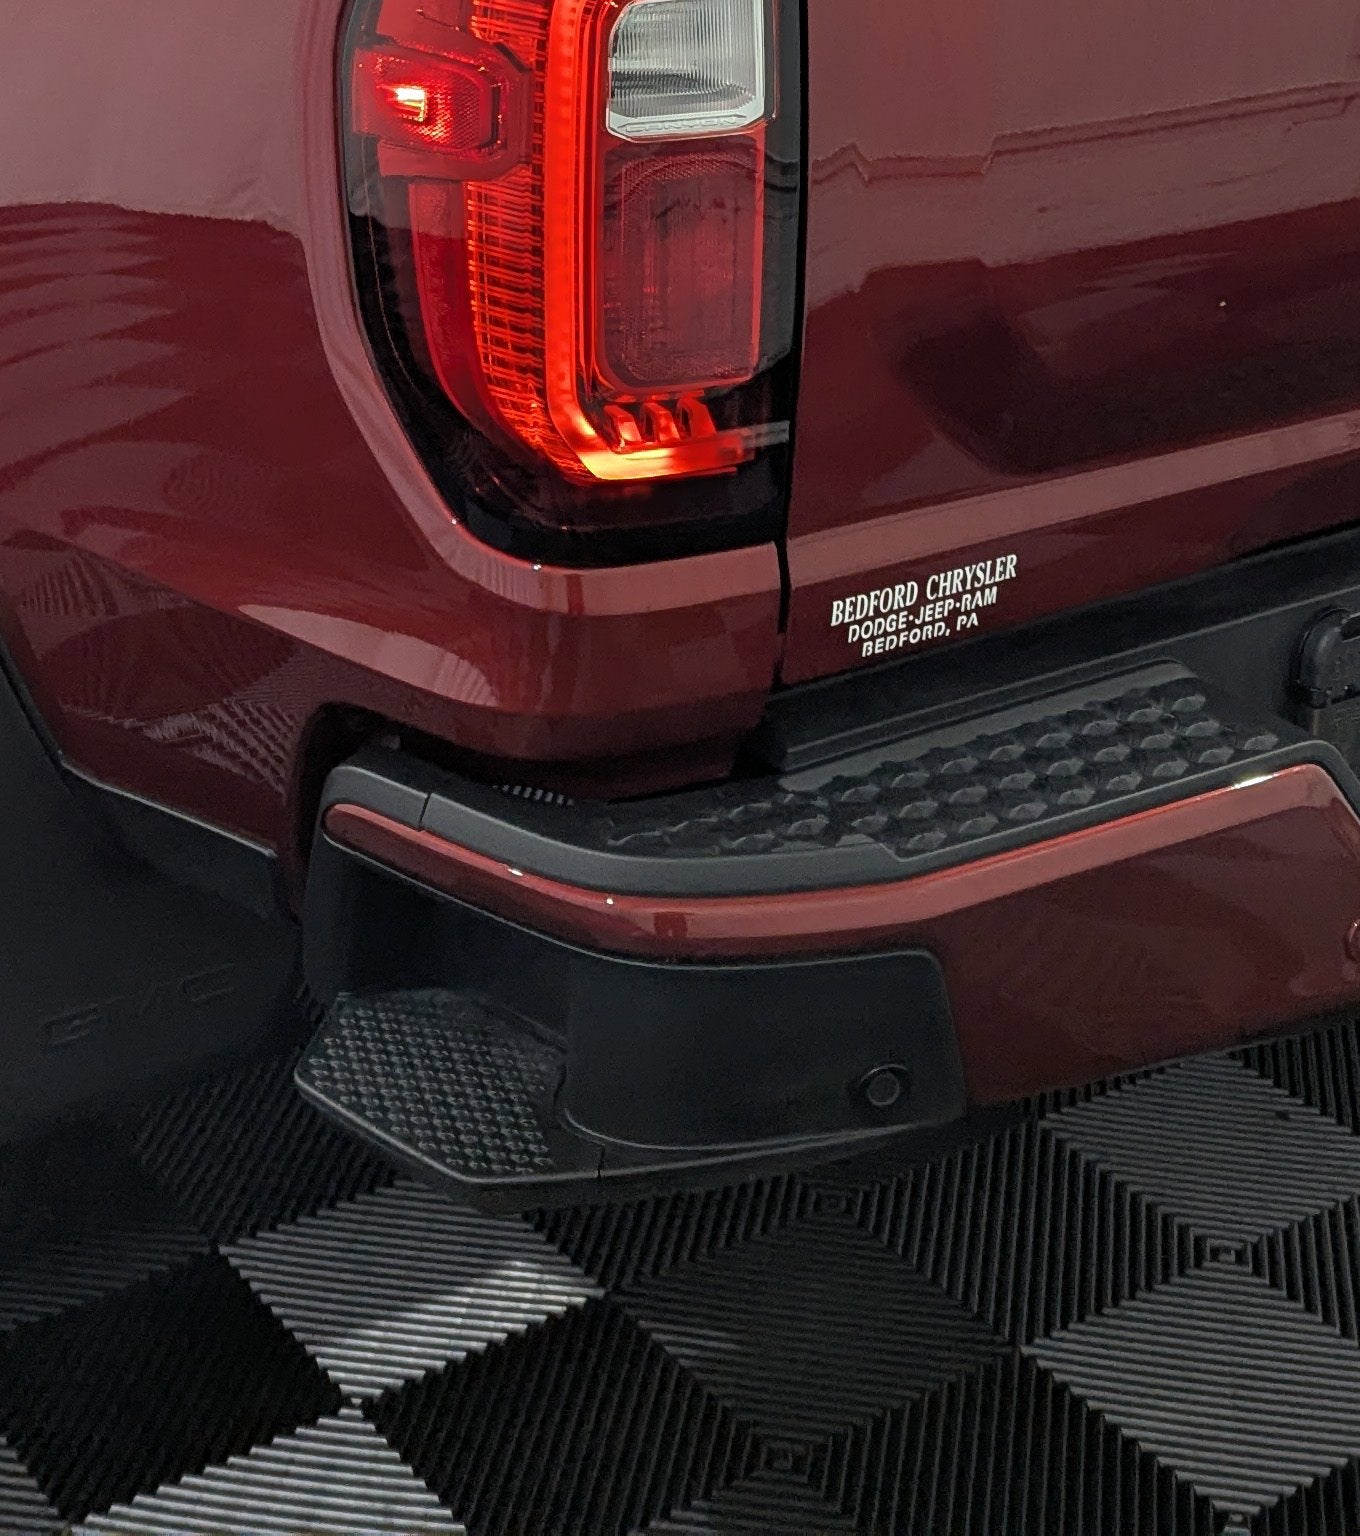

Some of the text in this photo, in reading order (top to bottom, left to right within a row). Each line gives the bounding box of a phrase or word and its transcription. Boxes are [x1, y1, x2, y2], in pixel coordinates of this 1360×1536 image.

[830, 553, 1018, 627] BEDFORD CHRYSLER
[861, 612, 980, 658] BEDFORD, PA
